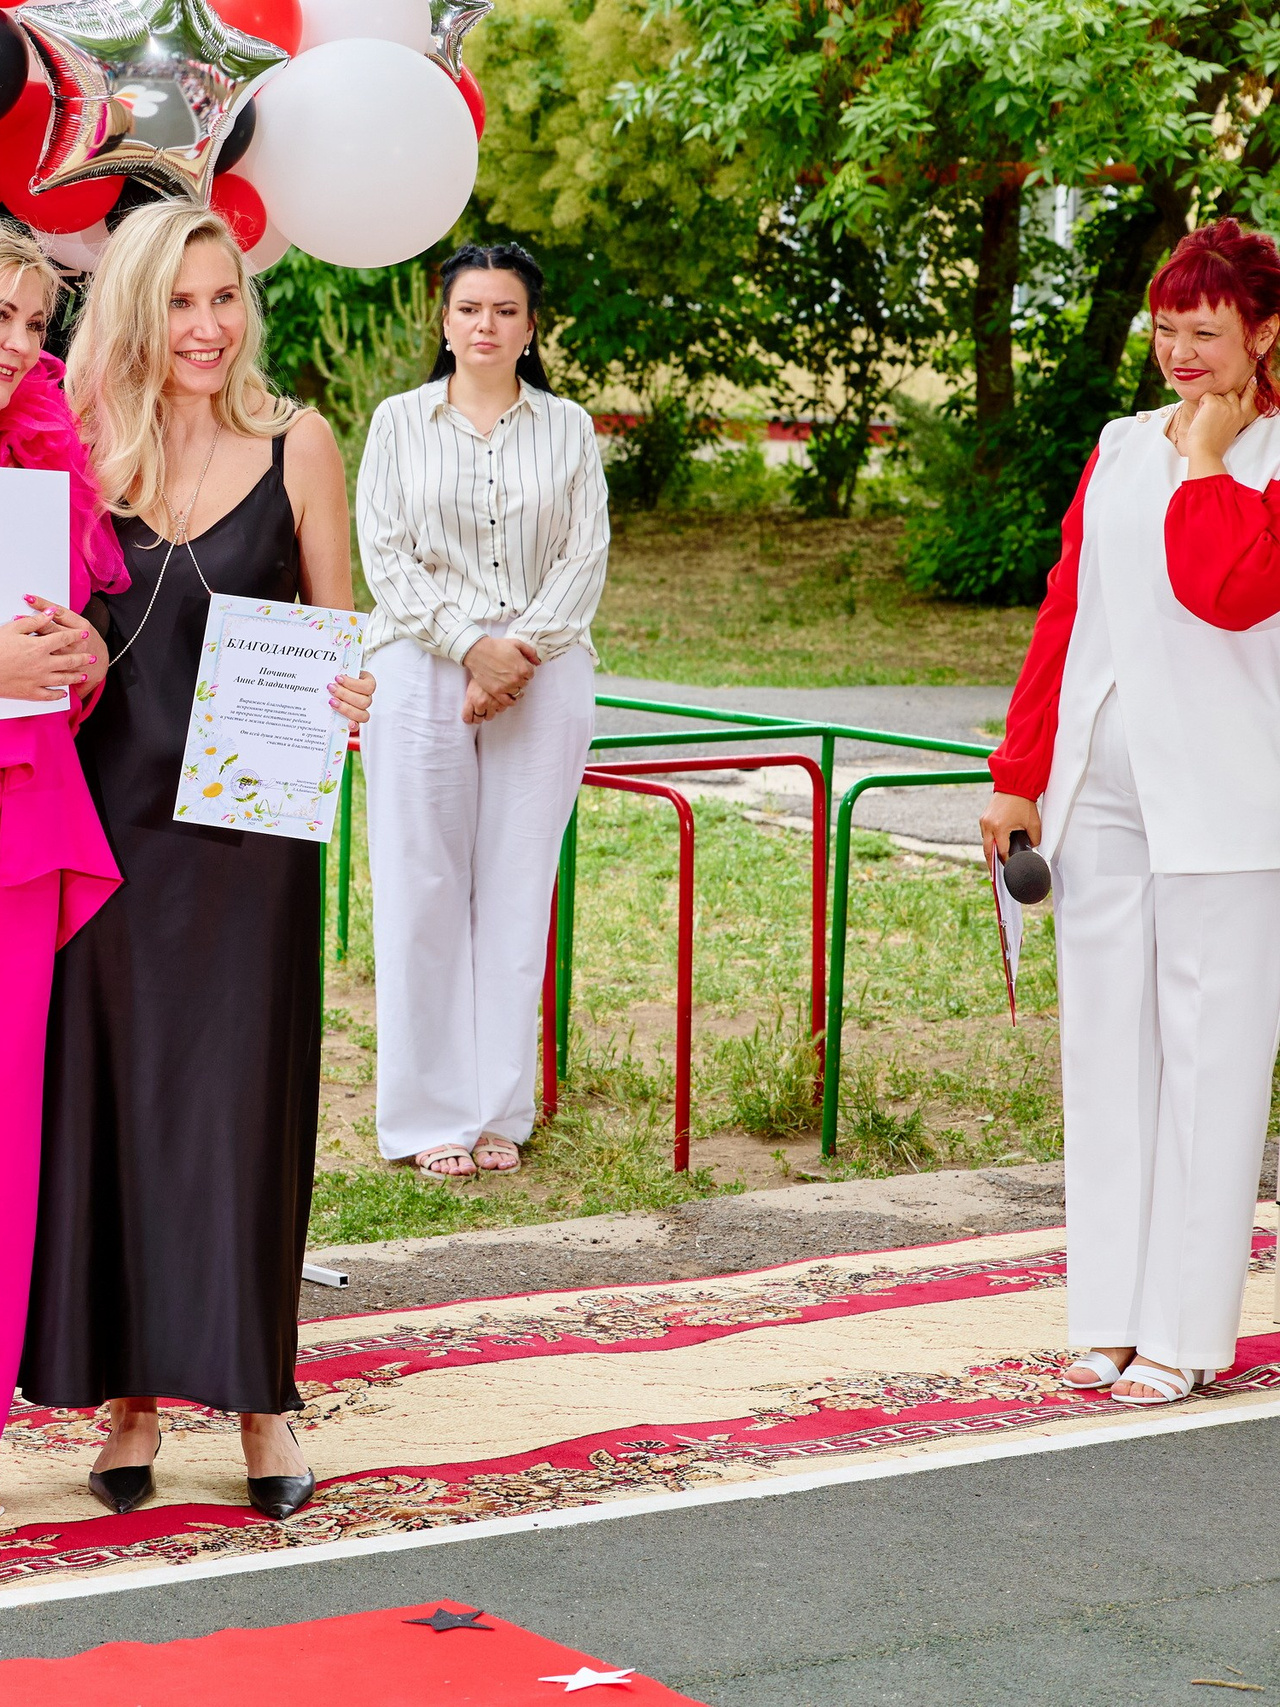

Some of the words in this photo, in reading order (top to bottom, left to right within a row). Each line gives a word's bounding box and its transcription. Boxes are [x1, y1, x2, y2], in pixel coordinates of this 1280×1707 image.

[227, 638, 337, 662] БЛАГОДАРНОСТЬ
[259, 667, 297, 679] Починок
[233, 675, 255, 685] Анне
[257, 678, 319, 693] Владимировне
